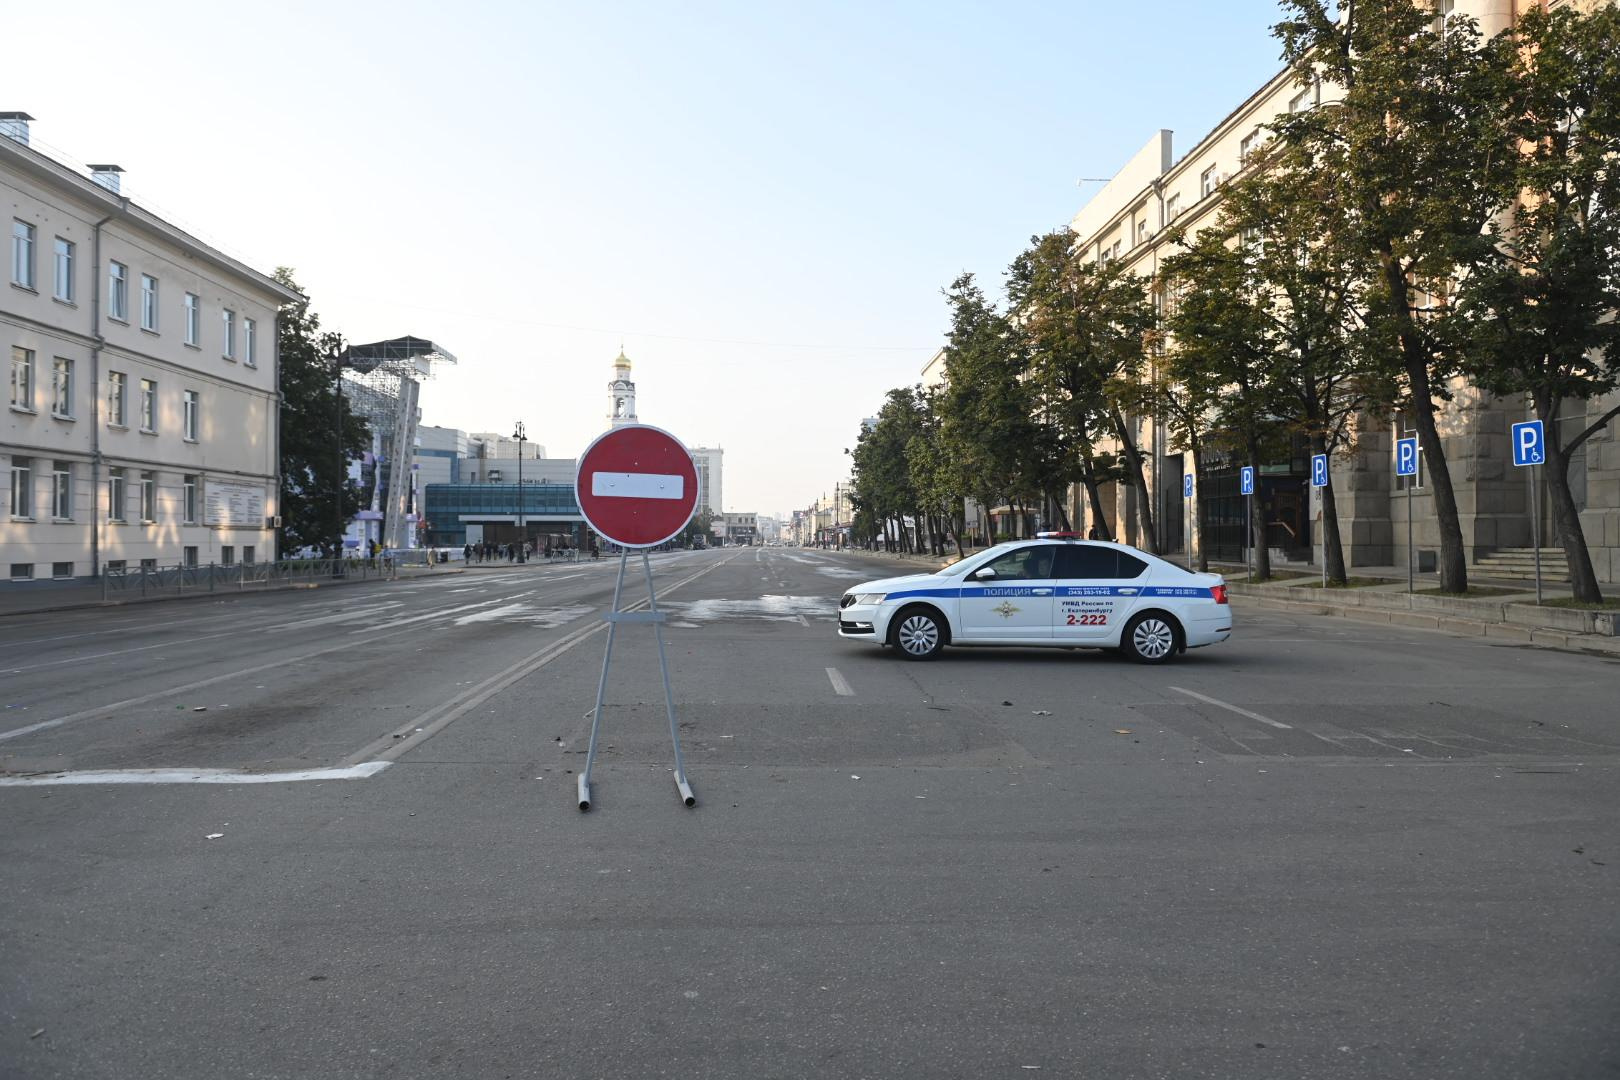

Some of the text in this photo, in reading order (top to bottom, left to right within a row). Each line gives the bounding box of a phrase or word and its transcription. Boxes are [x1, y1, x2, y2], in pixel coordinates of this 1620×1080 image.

[1520, 427, 1537, 461] P
[1401, 443, 1413, 472] P
[983, 588, 1031, 597] ПОЛИЦИЯ
[1066, 614, 1107, 625] 2-222
